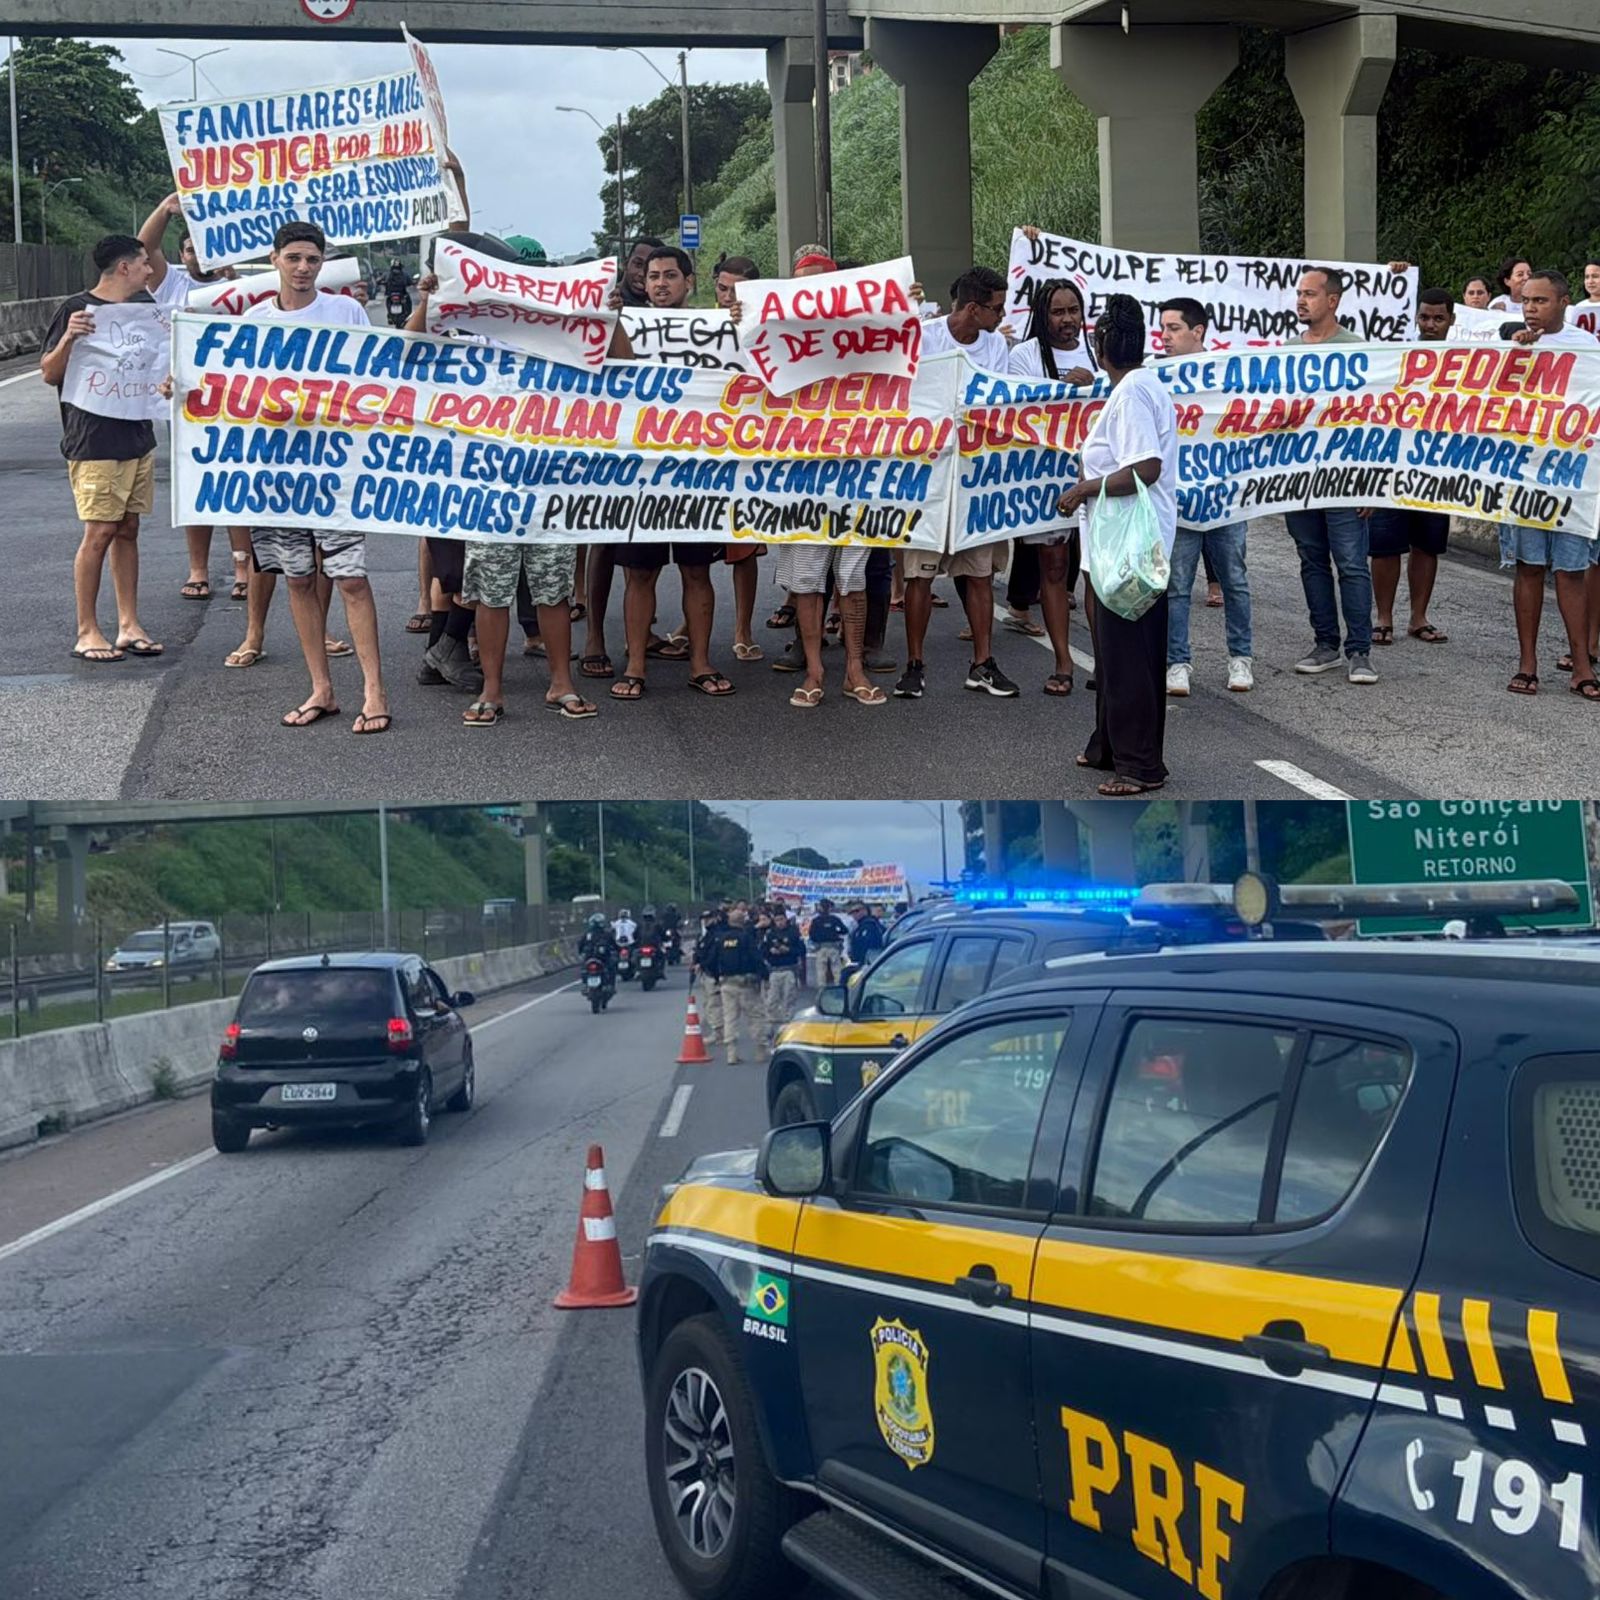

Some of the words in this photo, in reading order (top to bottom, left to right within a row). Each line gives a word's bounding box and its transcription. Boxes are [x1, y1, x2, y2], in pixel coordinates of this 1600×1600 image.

[176, 87, 361, 145] FAMILIARES
[364, 88, 372, 114] E
[375, 72, 424, 120] AMIG
[177, 133, 332, 192] JUSTIÇA
[335, 133, 370, 162] POR
[187, 182, 298, 221] JAMAIS
[305, 162, 363, 205] SERÁ
[460, 258, 608, 310] QUEREMOS
[760, 292, 785, 323] A
[792, 279, 909, 321] CULPA
[1028, 238, 1166, 283] DESCULPE
[1175, 257, 1229, 284] PELO
[1237, 260, 1410, 309] TRANORNO,
[440, 302, 607, 345] RESPOSTAS
[750, 330, 779, 383] É
[779, 328, 825, 362] DE
[832, 317, 921, 374] QUEM?
[194, 322, 494, 386] FAMILIARES
[498, 350, 516, 375] E
[518, 354, 693, 403] AMIGOS
[1202, 361, 1216, 388] E
[1222, 352, 1369, 394] AMIGOS
[1397, 347, 1577, 399] PEDEM
[185, 372, 417, 430] JUSTIÇA
[430, 393, 517, 434] POR
[514, 394, 622, 446] ALAN
[634, 406, 953, 459] NASCIMENTO!
[1214, 398, 1315, 438] ALAN
[1316, 391, 1600, 449] NASCIMENTO!
[192, 426, 353, 468] JAMAIS
[362, 430, 455, 478] SERÁ
[461, 442, 646, 489] ESQUECIDO,
[651, 455, 739, 493] PARA
[745, 459, 881, 500] SEMPRE
[879, 461, 932, 501] EM
[1178, 429, 1321, 483] ESQUECIDO,
[1323, 427, 1401, 464] PARA
[1407, 430, 1534, 481] SEMPRE
[1537, 449, 1588, 489] EM
[195, 470, 341, 517] NOSSOS
[351, 474, 536, 536] CORAÇÕES!
[733, 497, 827, 532] ESTAMOS
[829, 503, 850, 539] DE
[856, 504, 922, 543] LUTO!
[1394, 468, 1481, 507] ESTAMOS
[1482, 482, 1504, 514] DE
[1509, 485, 1572, 527] LUTO!
[1414, 822, 1519, 850] Niterói
[1439, 800, 1562, 817] Gonçalo
[1424, 856, 1516, 877] RETORNO
[743, 1318, 788, 1343] BRASIL
[1060, 1405, 1245, 1600] PRF
[1452, 1450, 1583, 1551] 191
